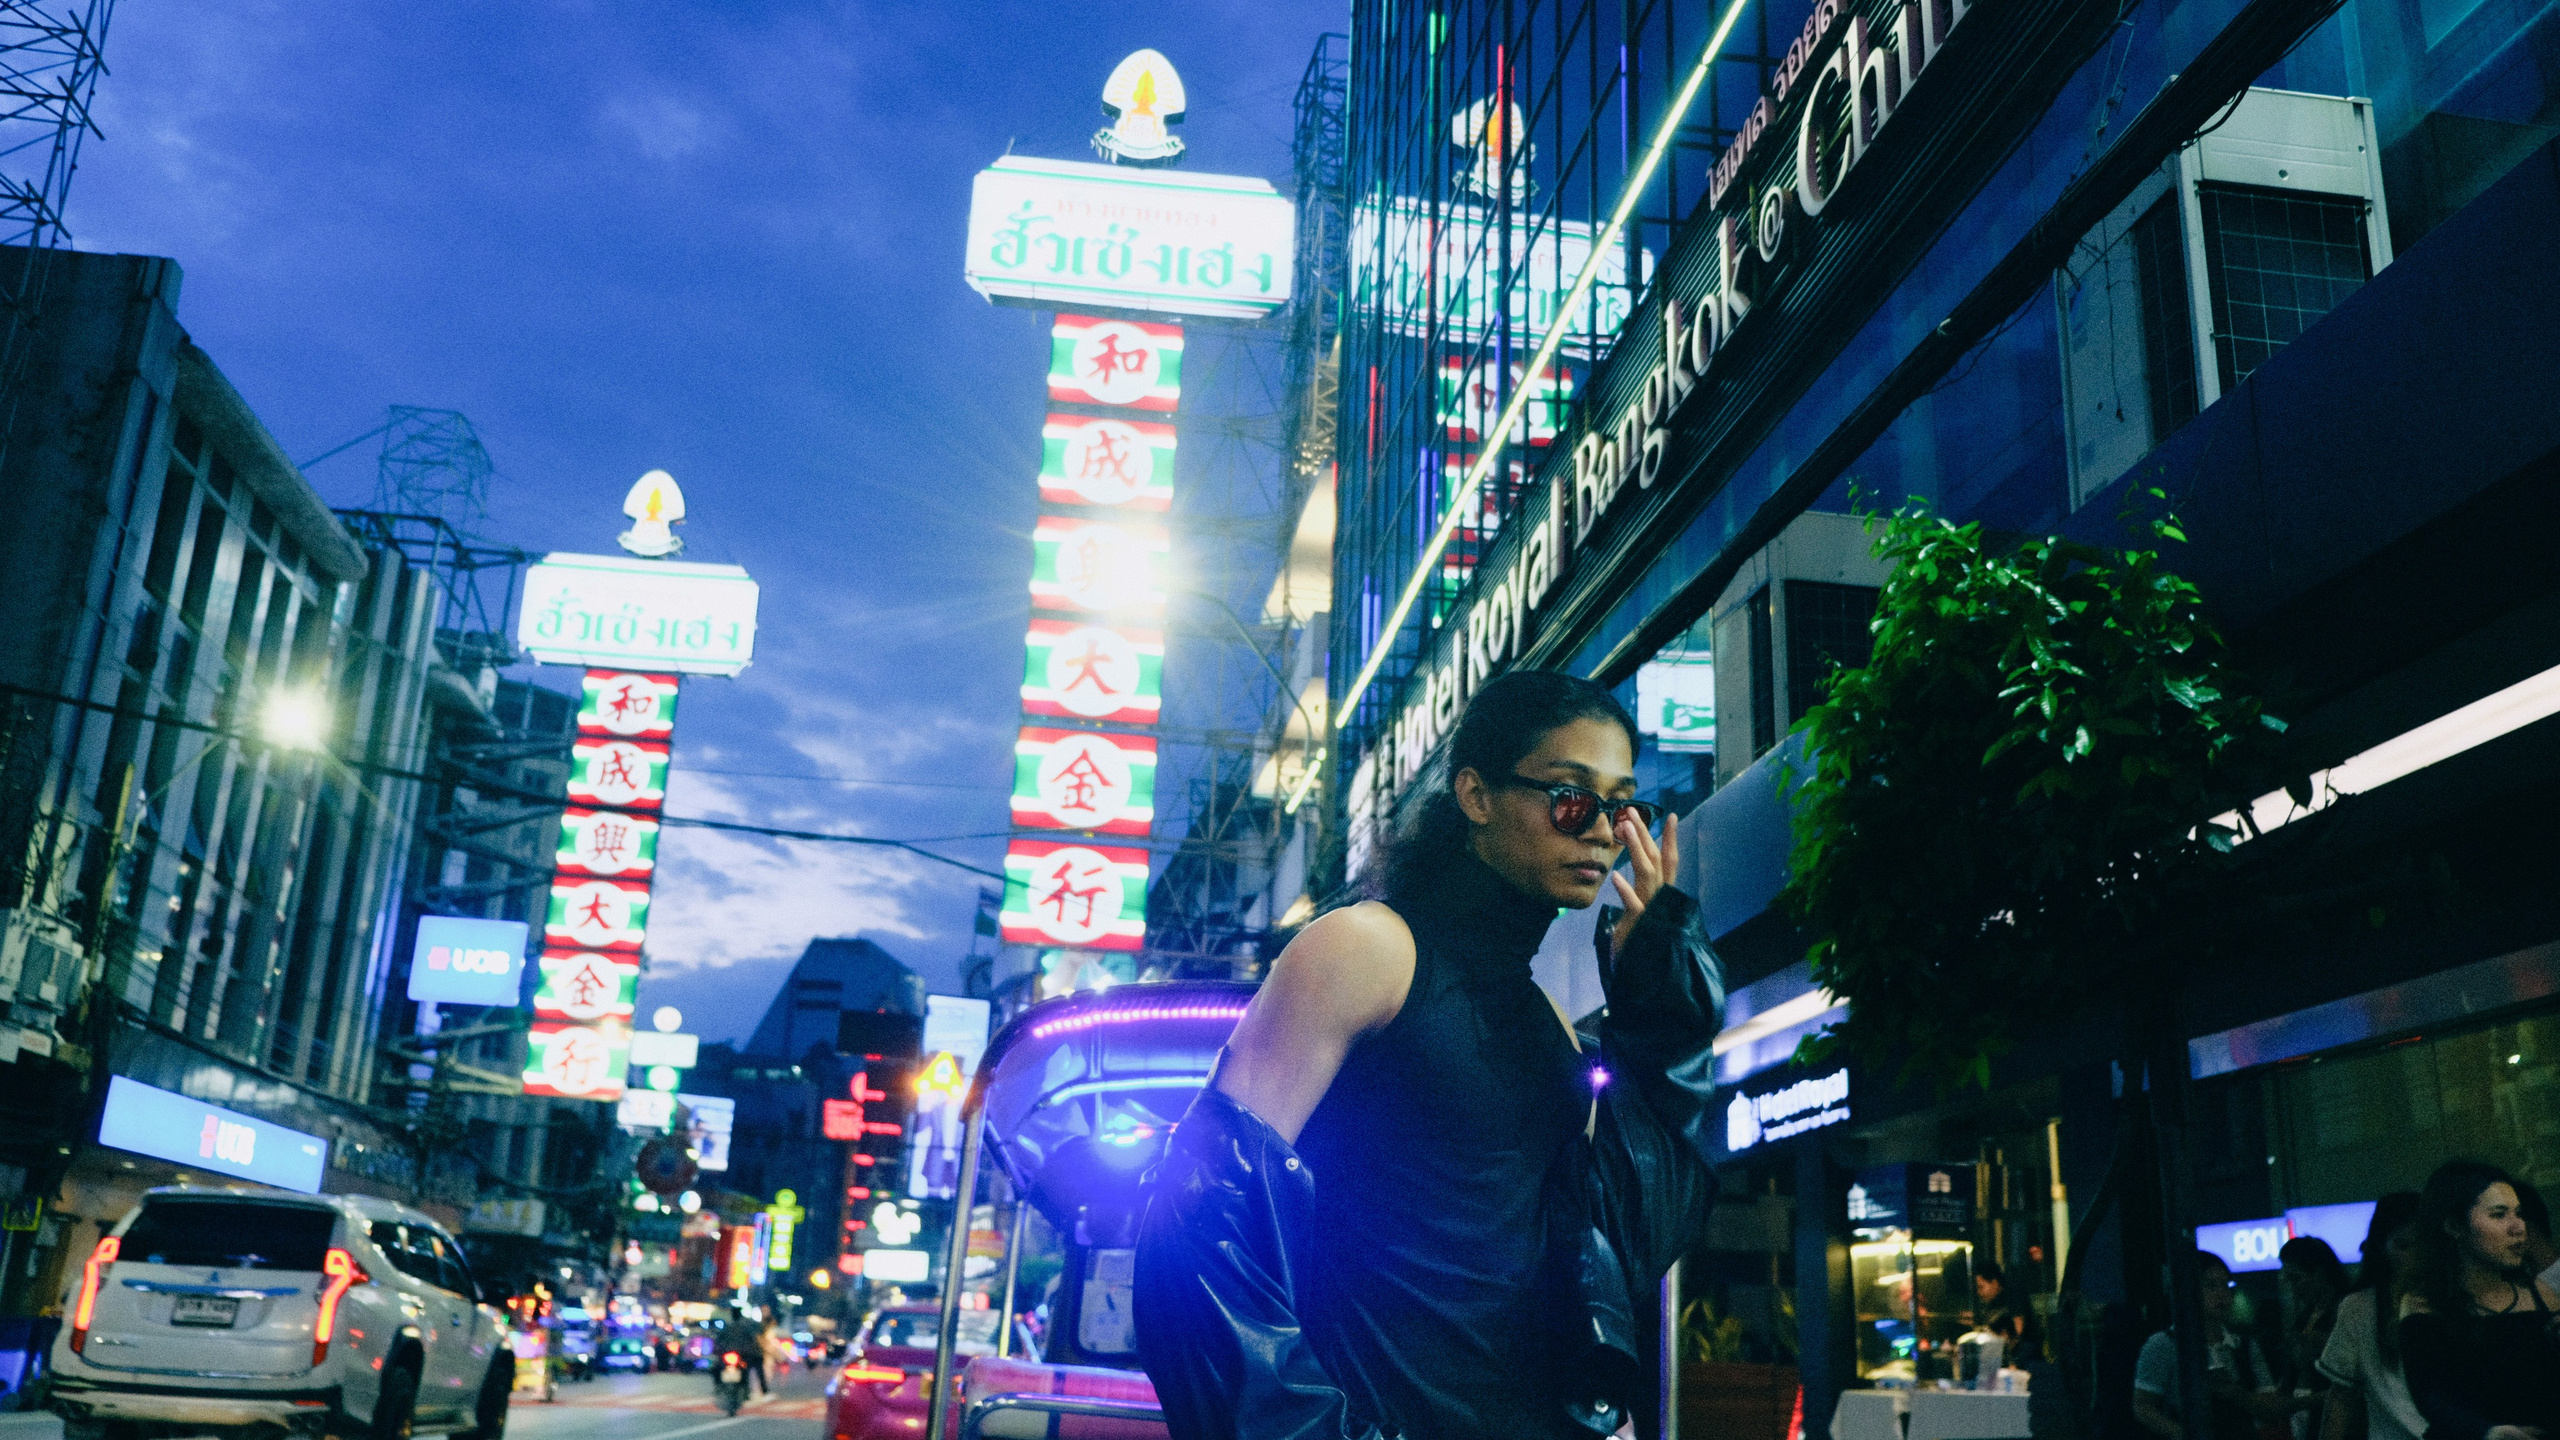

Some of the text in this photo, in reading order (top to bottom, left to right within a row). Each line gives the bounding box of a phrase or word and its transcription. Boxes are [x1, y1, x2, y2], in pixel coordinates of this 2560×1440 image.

[1772, 0, 1840, 102] รอยล
[1394, 629, 1463, 797] Hotel
[1467, 476, 1564, 697] Royal
[1573, 217, 1750, 550] Bangkok
[1758, 186, 1790, 264] @
[453, 948, 510, 975] UOB
[216, 1120, 256, 1166] UOB
